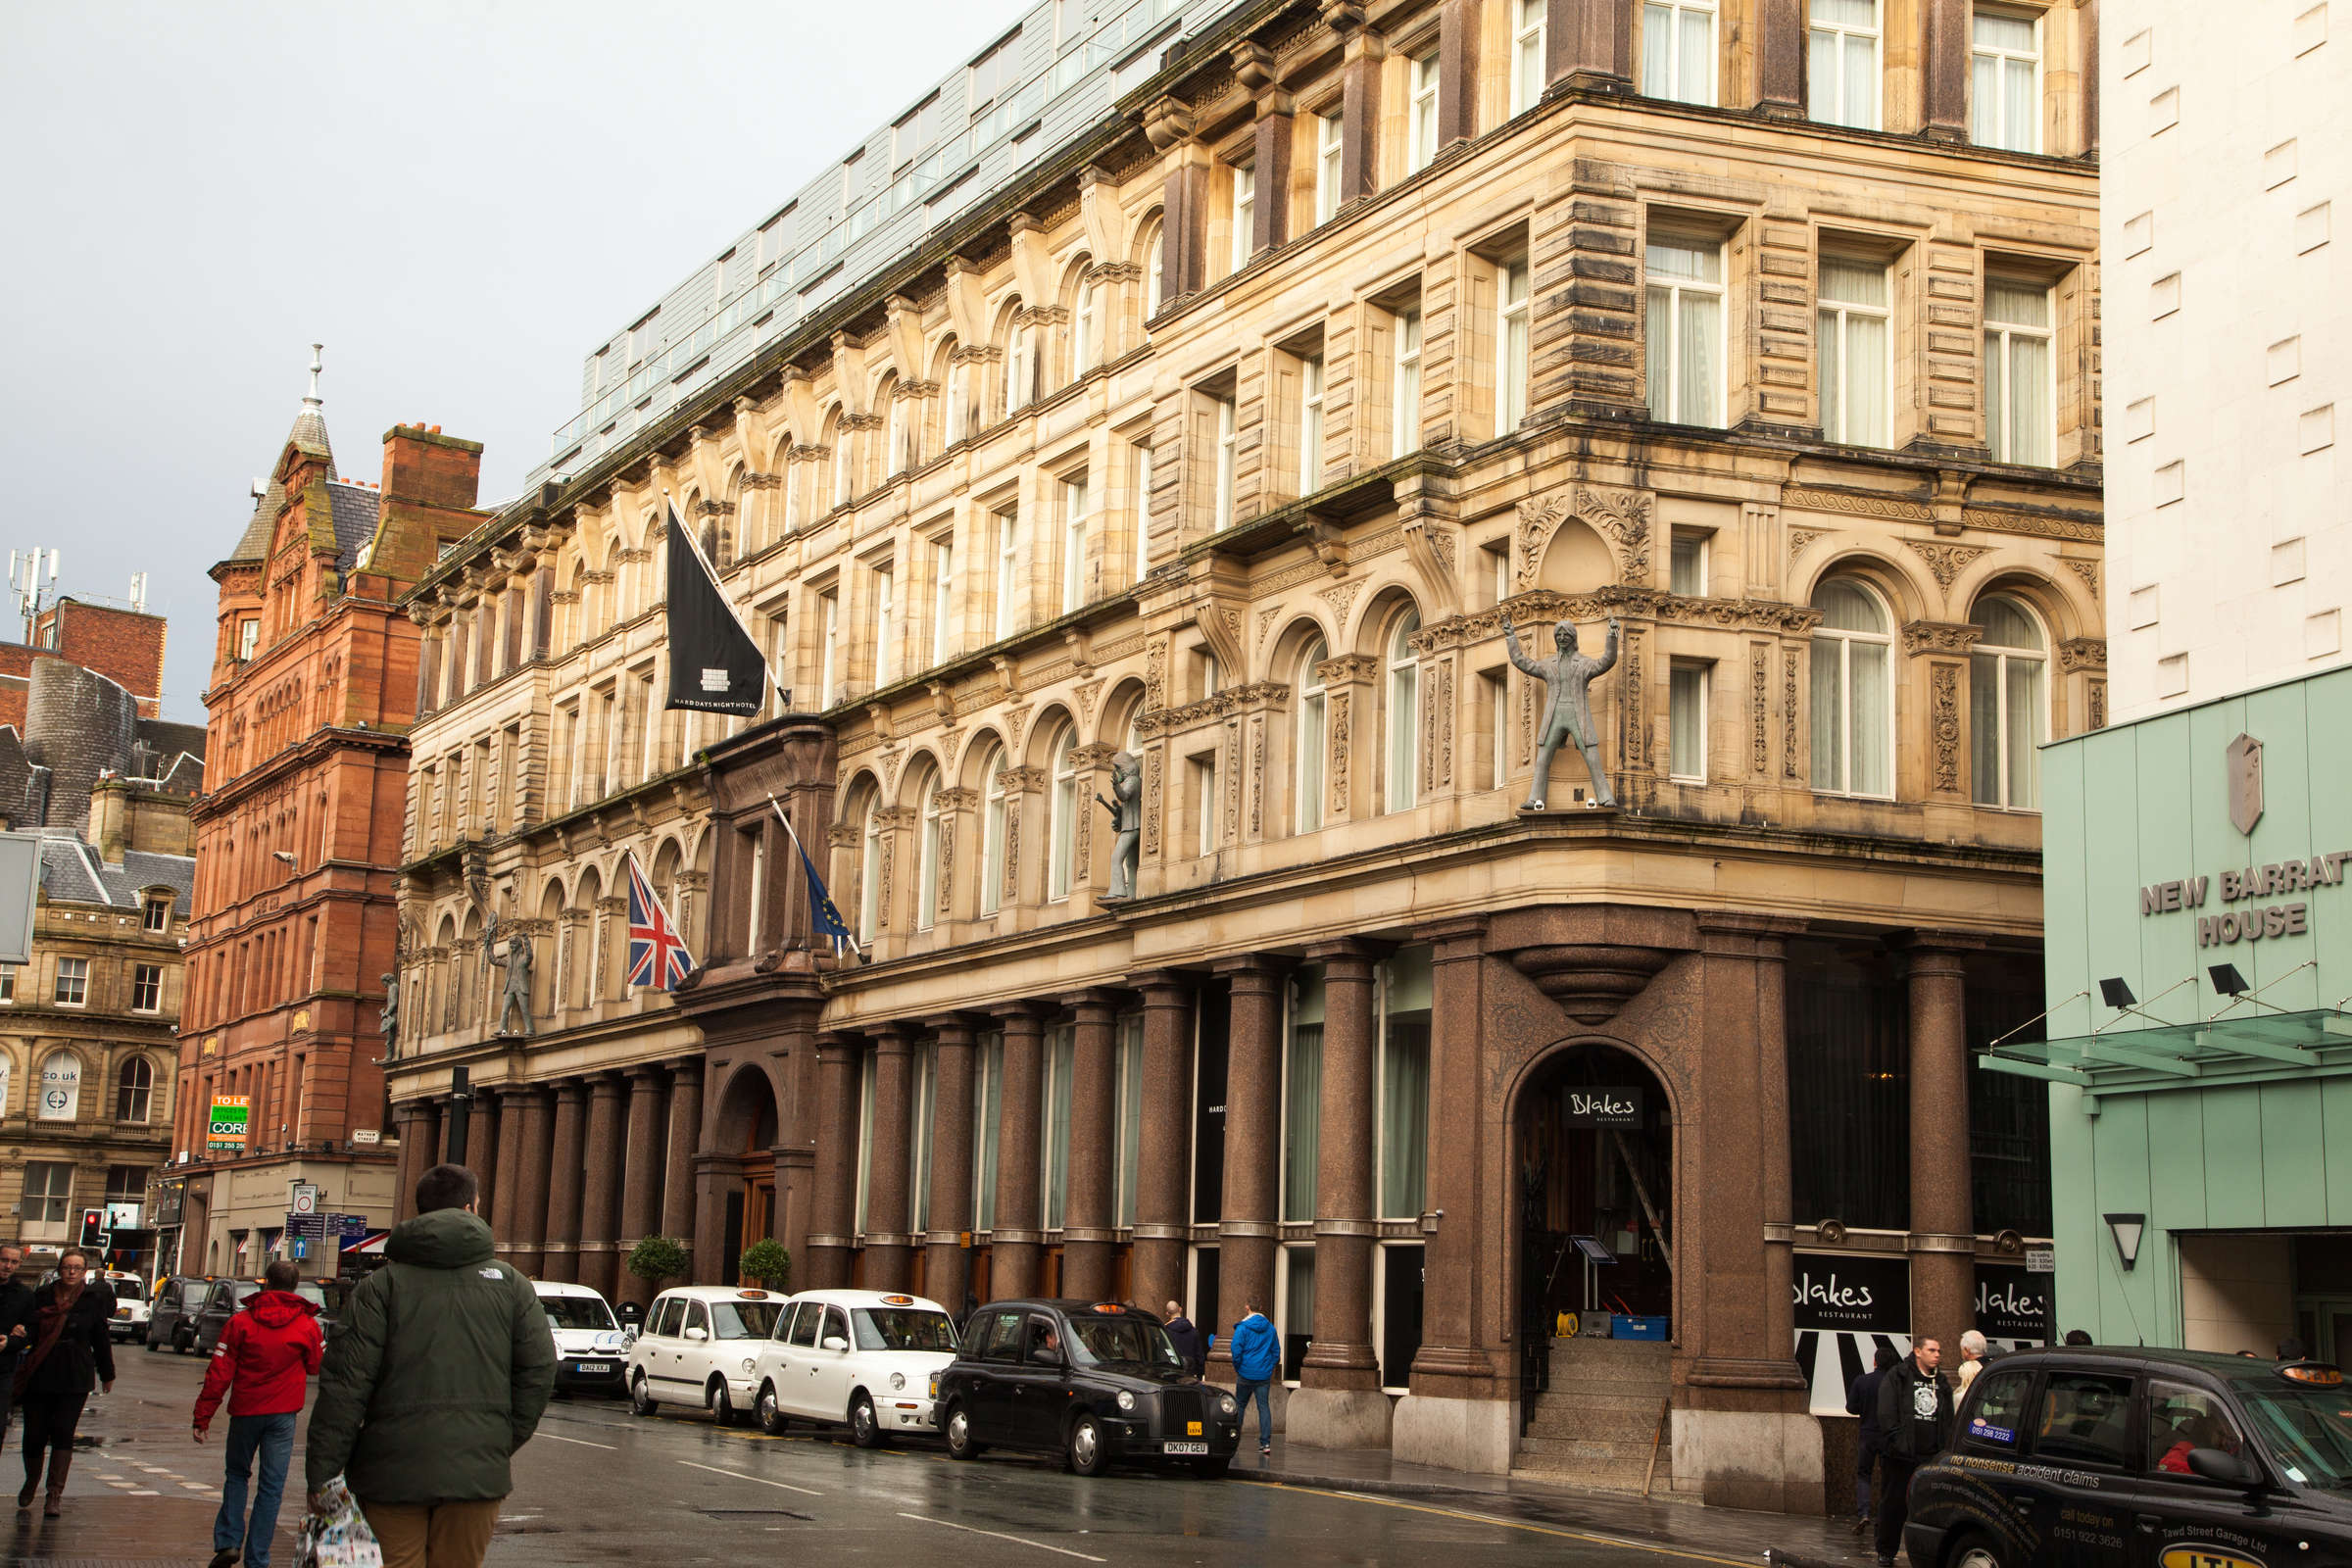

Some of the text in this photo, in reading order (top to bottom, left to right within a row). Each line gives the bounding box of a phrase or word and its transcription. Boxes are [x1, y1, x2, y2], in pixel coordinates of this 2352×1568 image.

[2141, 850, 2352, 917] NEW BARRAT
[2198, 902, 2308, 949] HOUSE
[217, 1097, 231, 1105] TO
[1571, 1094, 1635, 1115] Blakes
[1818, 1311, 1874, 1320] RESTAURANT
[1994, 1430, 2010, 1441] 2222
[1167, 1443, 1205, 1452] DK07 GEU
[1950, 1454, 2100, 1489] no nonsense accident claims
[2061, 1509, 2114, 1528] call today on
[2054, 1526, 2077, 1541] 0151
[2162, 1525, 2268, 1553] Tawd Street Garage Ltd
